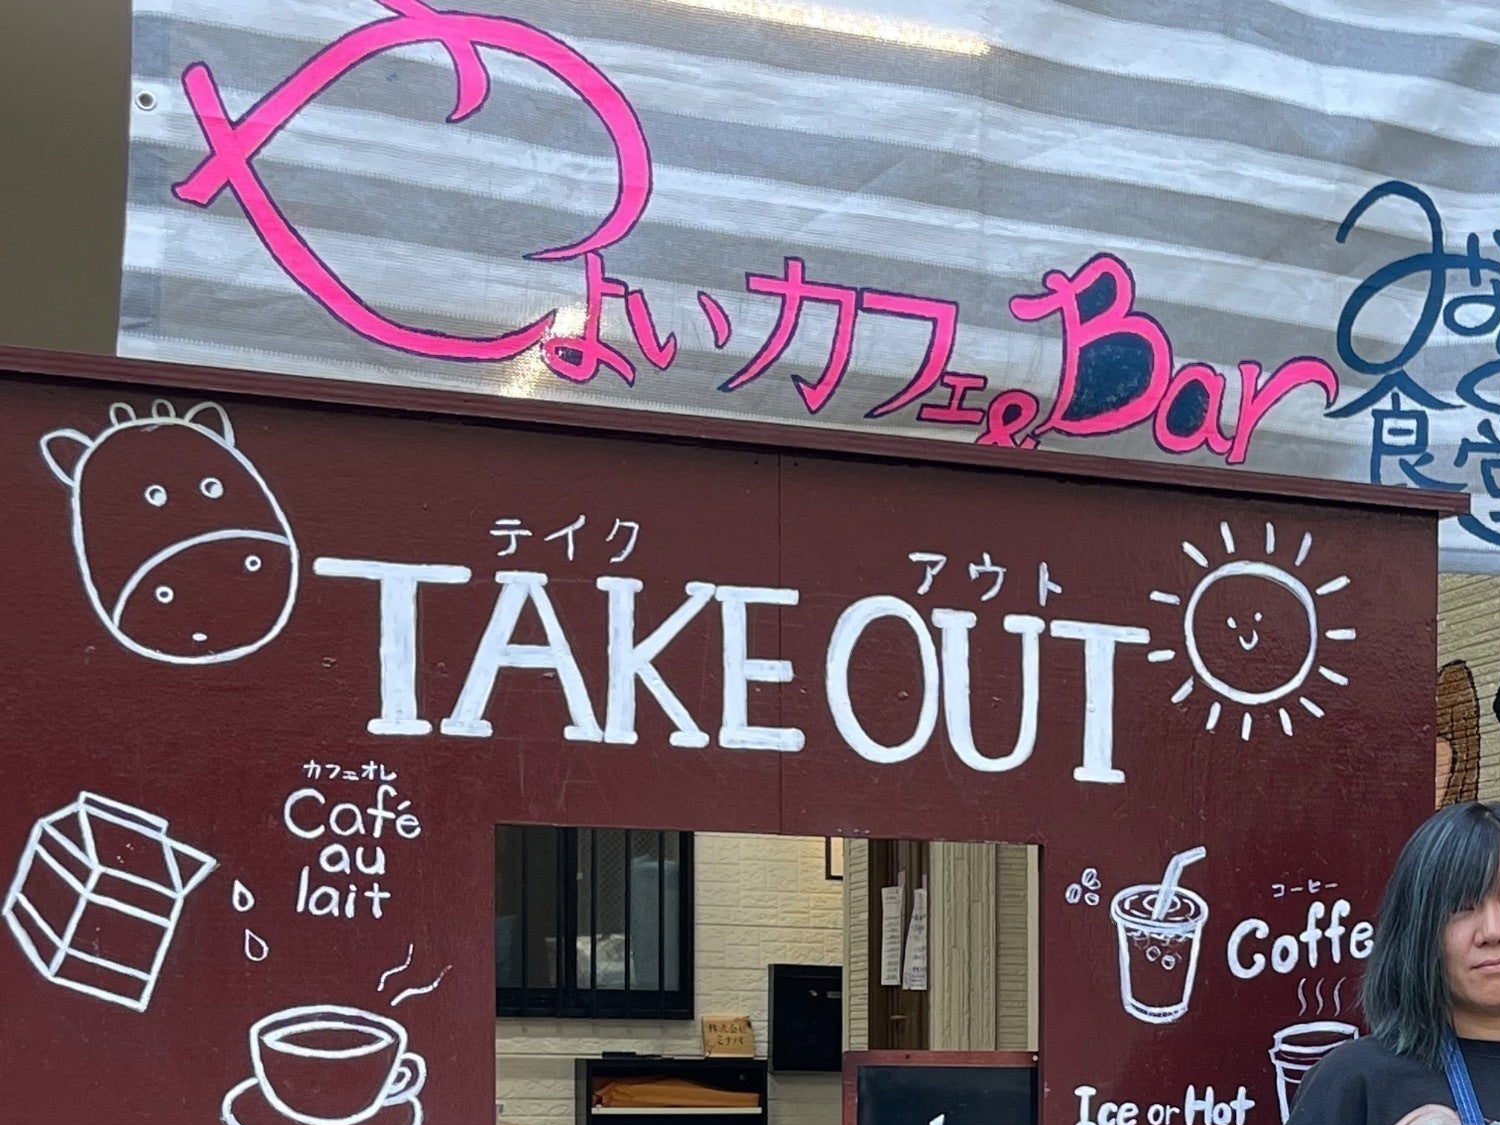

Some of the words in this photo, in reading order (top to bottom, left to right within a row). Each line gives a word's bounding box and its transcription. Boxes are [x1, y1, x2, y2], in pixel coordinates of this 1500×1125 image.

[489, 515, 640, 563] テイク
[908, 552, 1062, 607] アウト
[303, 760, 397, 781] カフェオレ
[283, 785, 422, 839] Café
[319, 843, 386, 875] au
[297, 866, 391, 919] lait
[1271, 879, 1338, 898] コーヒー
